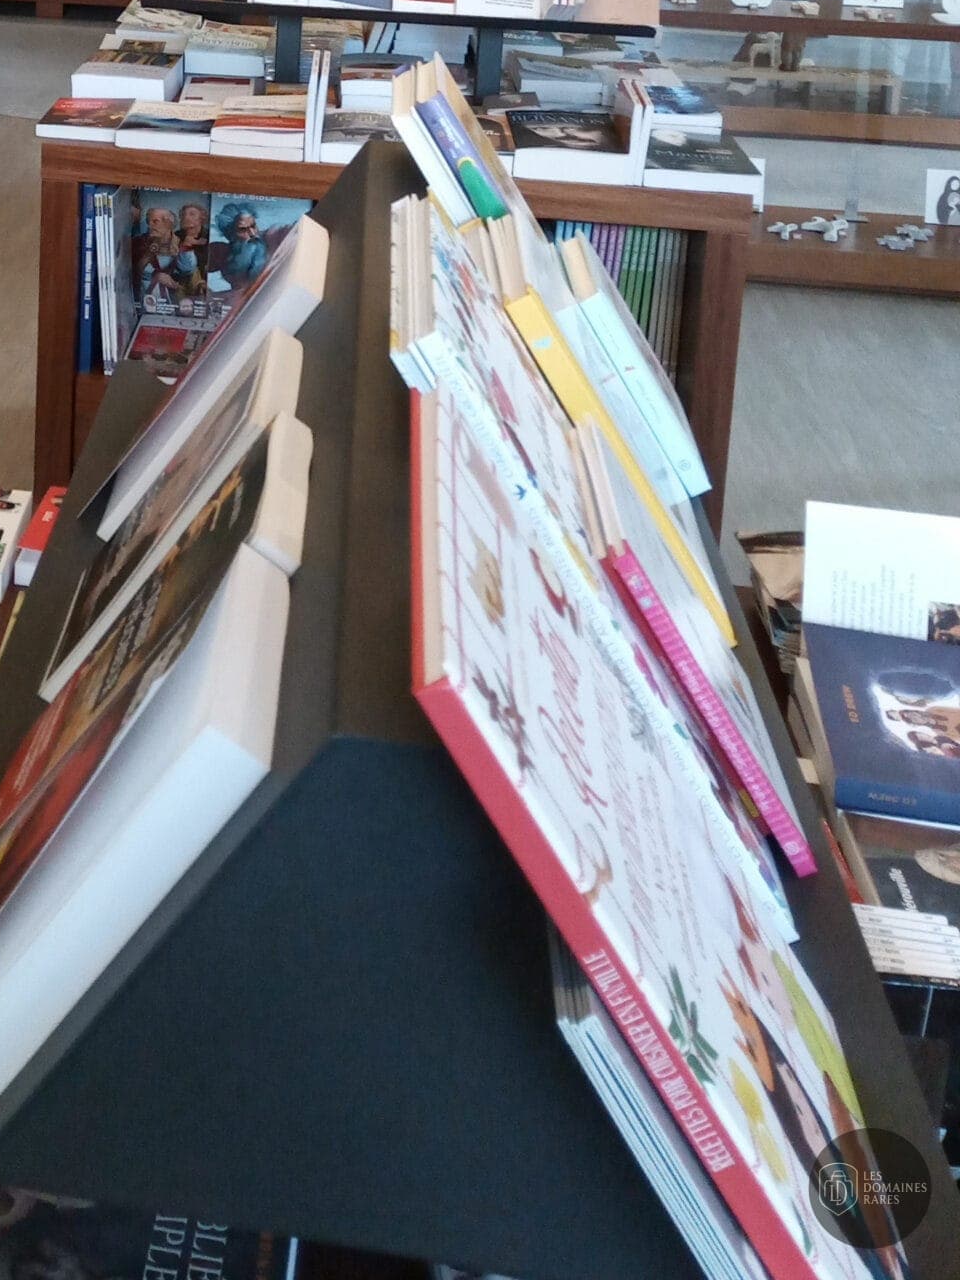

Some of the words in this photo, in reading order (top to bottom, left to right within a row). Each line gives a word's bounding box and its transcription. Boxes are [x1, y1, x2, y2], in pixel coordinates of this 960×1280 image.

[583, 949, 632, 1007] FAMILLE
[617, 1001, 644, 1026] EN
[628, 1021, 677, 1079] CUISINER
[661, 1076, 696, 1111] POUR
[681, 1103, 736, 1173] RECETTES
